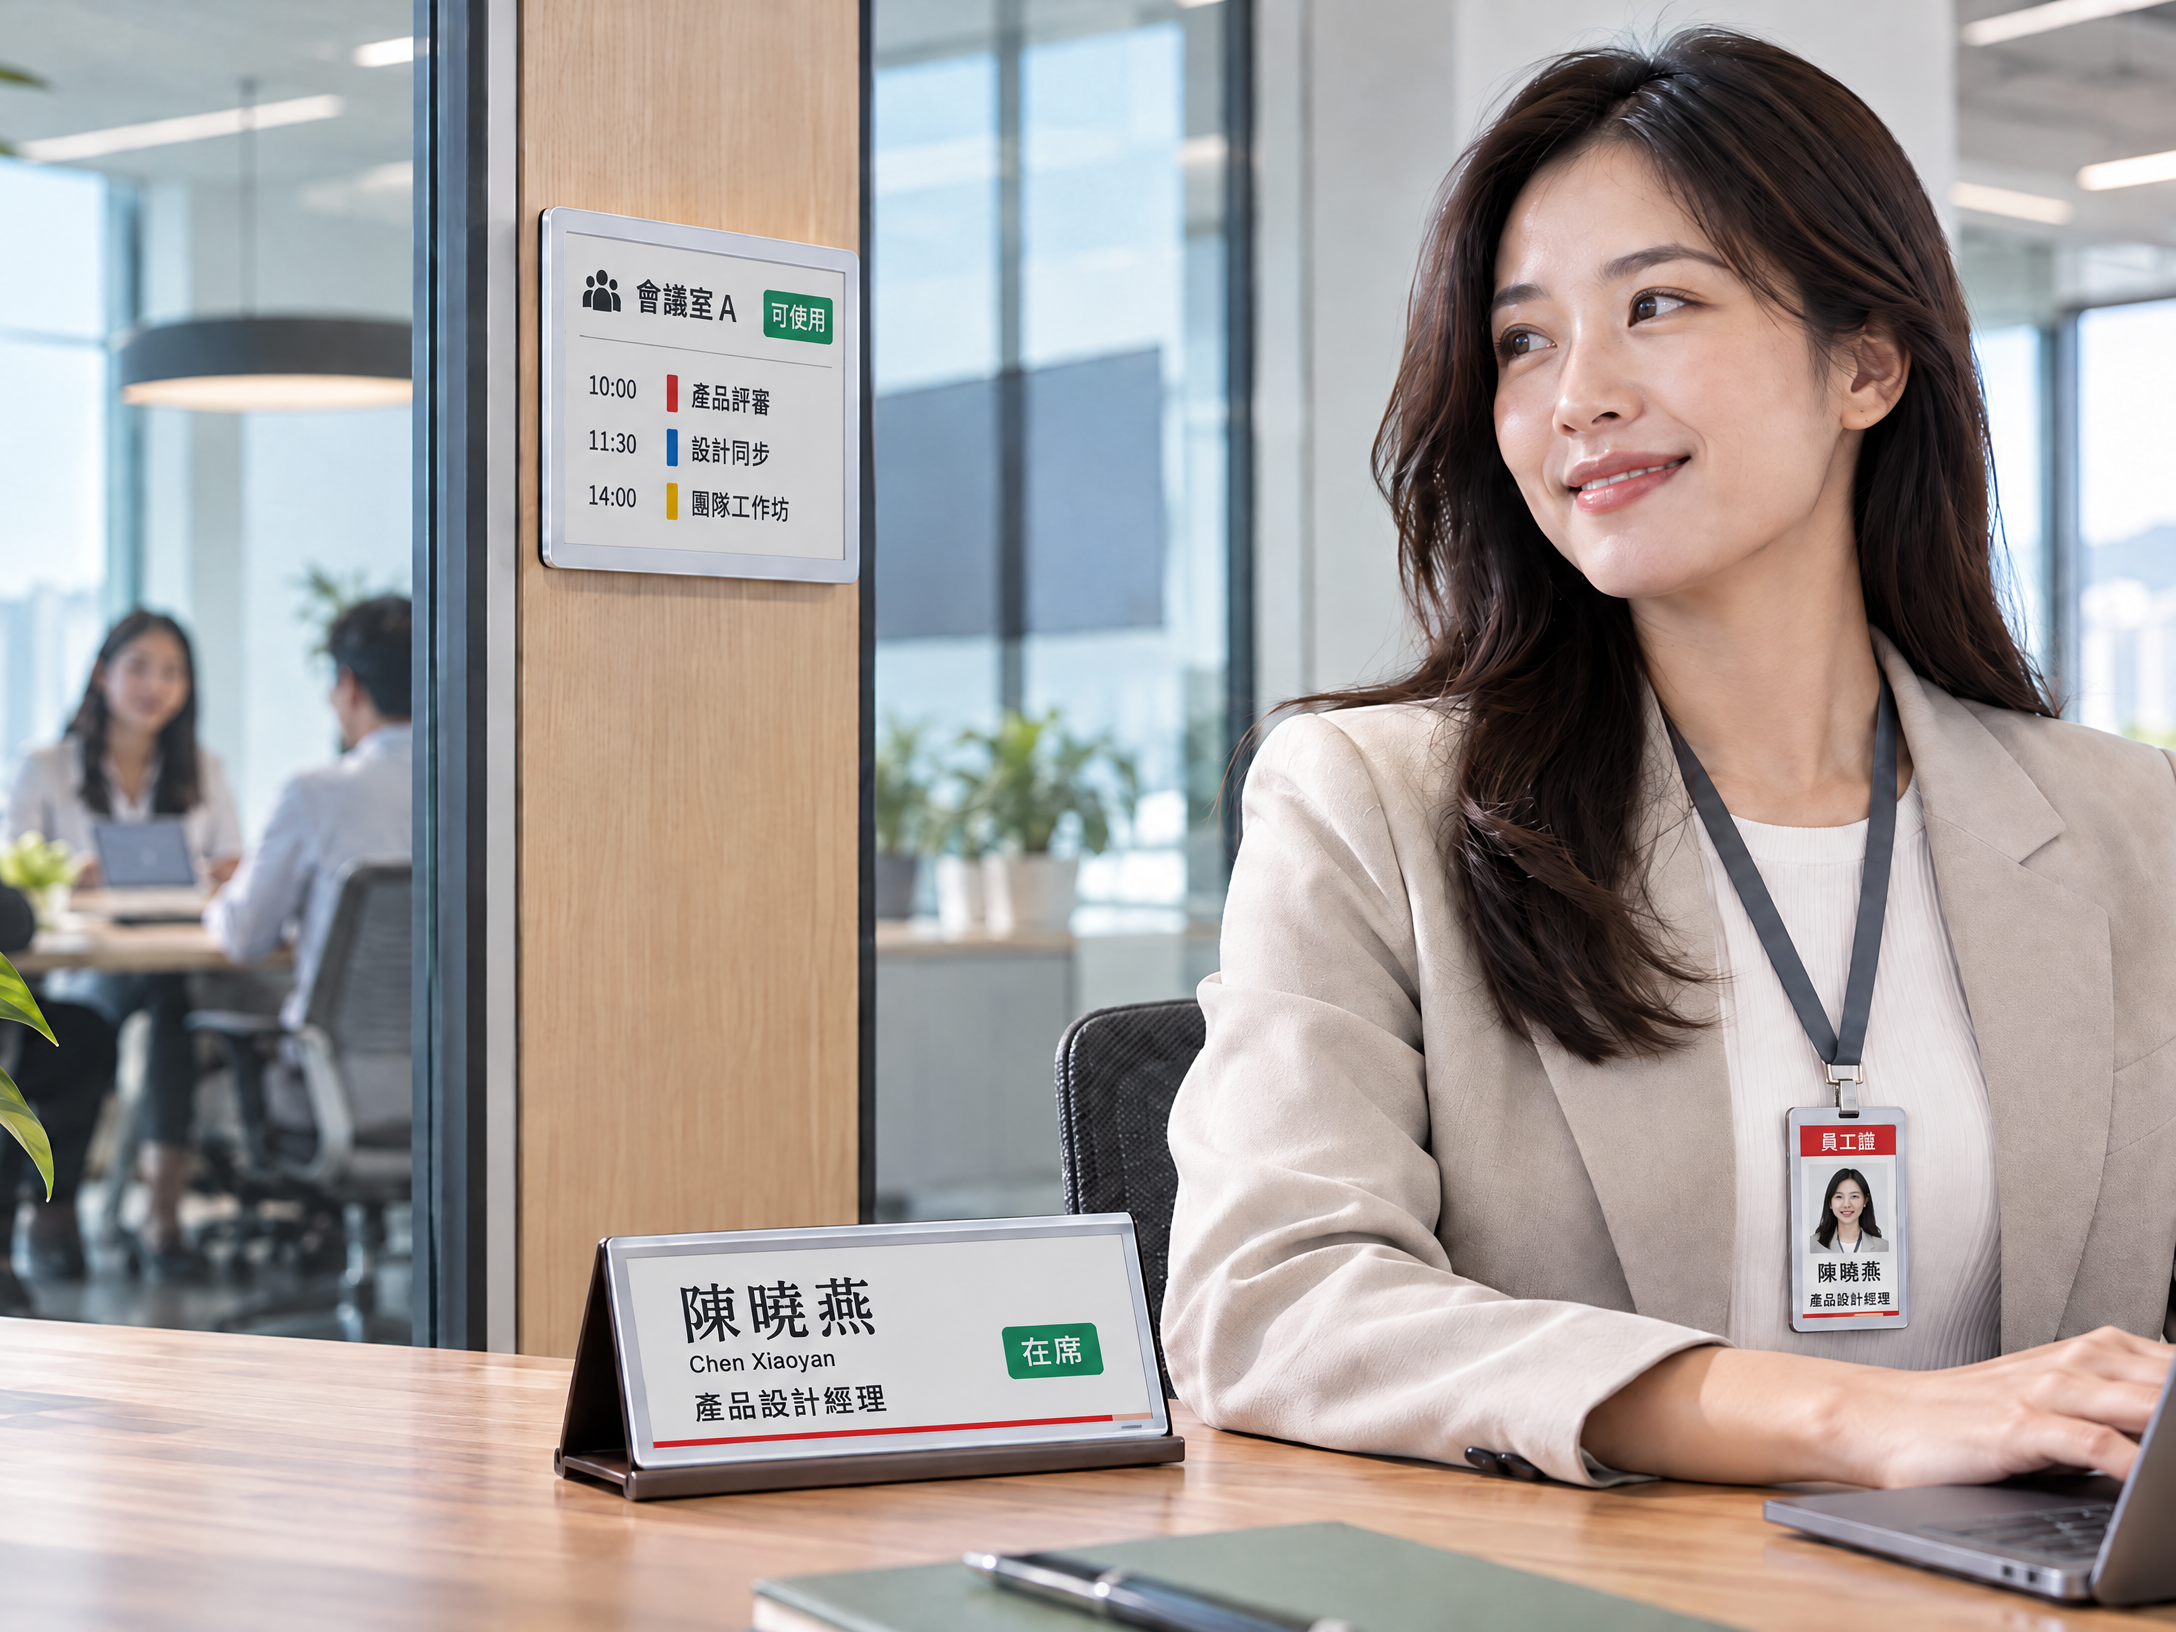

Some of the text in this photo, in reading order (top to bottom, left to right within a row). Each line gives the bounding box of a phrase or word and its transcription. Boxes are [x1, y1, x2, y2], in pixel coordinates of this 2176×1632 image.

[636, 278, 738, 323] 會議室 A
[771, 302, 825, 333] 可使用
[589, 374, 637, 400] 10:00
[691, 382, 770, 417] 產品評審
[589, 429, 637, 455] 11:30
[691, 435, 770, 467] 設計同步
[588, 484, 637, 508] 14:00
[692, 490, 790, 523] 團隊工作坊
[1817, 1260, 1881, 1284] 陳曉燕
[679, 1276, 876, 1344] 陳曉燕
[689, 1351, 836, 1374] Chen Xiaoyan
[1020, 1335, 1082, 1367] 在席
[694, 1384, 888, 1423] 產品設計經理
